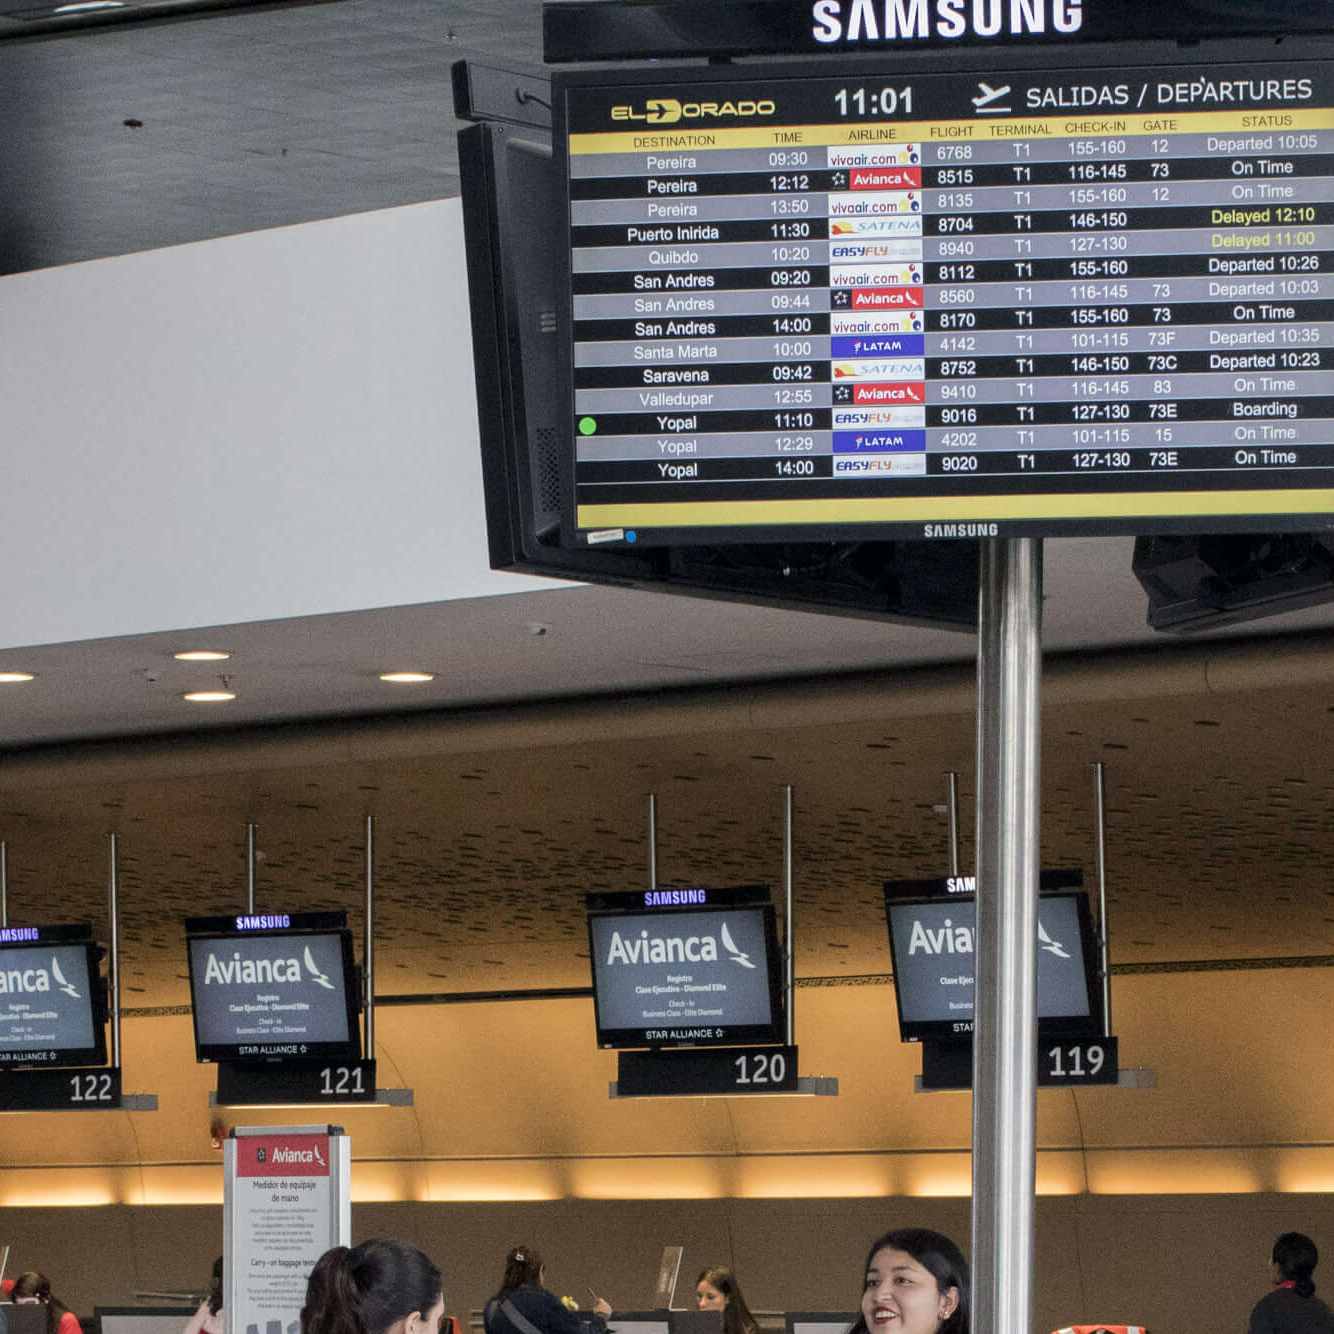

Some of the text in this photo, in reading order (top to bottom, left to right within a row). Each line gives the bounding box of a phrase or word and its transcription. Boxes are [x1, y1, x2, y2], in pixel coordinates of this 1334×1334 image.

[813, 0, 1082, 42] SAMSUNG
[835, 88, 912, 116] 11:01
[1027, 85, 1128, 107] SALIDAS
[1157, 79, 1312, 102] DEPARTURES
[634, 115, 1291, 148] DESTINATION TIME AIRLINE FLIGHT TERMINAL CHECK-IN GATE STATUS
[647, 157, 696, 169] Pereira
[769, 152, 807, 165] 09:30
[937, 146, 972, 159] 6768
[1014, 143, 1030, 156] T1
[1068, 142, 1125, 154] 155-160
[1152, 139, 1168, 152] 12
[1207, 137, 1274, 152] Departed
[1279, 135, 1317, 148] 10:05
[648, 161, 1293, 193] Pereira 12:12 Avianca 8515 T1 116-145 73 On Time
[628, 208, 1314, 242] Puerto Inirida 11:30 SATENA 8704 T1 146-150 Delayed 12:10
[649, 232, 1314, 266] Quibdo 10:20 EASYFLY 8940 T1 127-130 Delayed 11:00
[635, 329, 1319, 359] Santa Marta 10:00 LATAM 4142 T1 101-115 73F Departed 10:35
[643, 353, 1319, 383] Saravena 09:42 SATENA 8752 T1 146-150 73C Departed 10:23
[640, 378, 1295, 408] Valledupar 12:55 Avianca 9410 T1 116-145 83 On Time
[658, 402, 1297, 431] Yopal 11:10 EASYFLY 9016 T1 127-130 73E Boarding
[924, 523, 998, 536] SAMSUNG
[645, 889, 706, 906] SAMSUNG
[236, 915, 290, 930] SAMSUNG
[607, 930, 717, 965] Avianca
[204, 952, 301, 984] Avianca
[646, 1030, 712, 1039] STAR ALLIANCE
[13, 1053, 47, 1061] ALLIANCE
[239, 1045, 297, 1054] STAR ALLIANCE
[1050, 1046, 1104, 1076] 119
[320, 1067, 365, 1094] 121
[735, 1055, 785, 1083] 120
[71, 1075, 112, 1101] 122
[272, 1147, 313, 1163] Avianca
[253, 1181, 316, 1191] Medidor de equipaje
[272, 1194, 279, 1202] de
